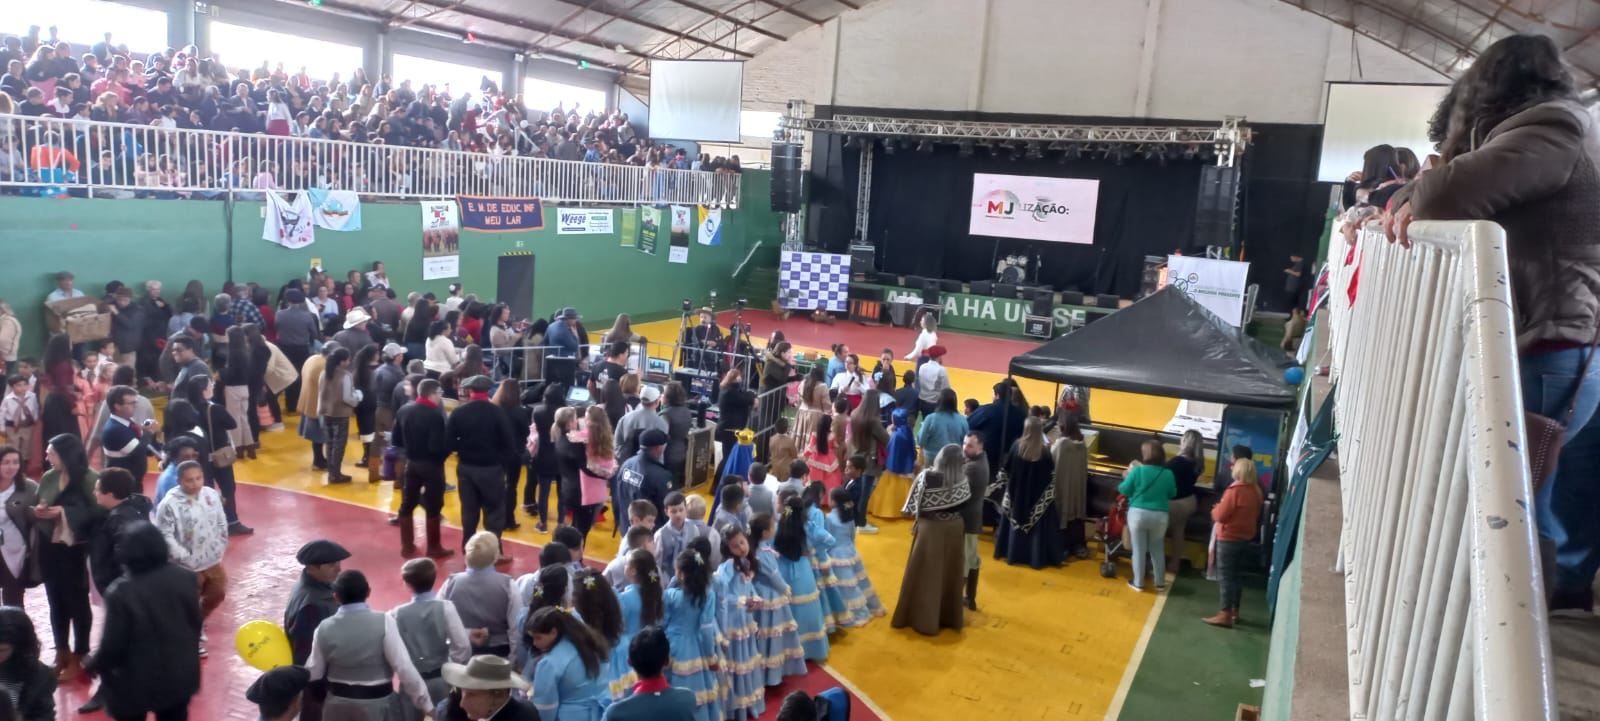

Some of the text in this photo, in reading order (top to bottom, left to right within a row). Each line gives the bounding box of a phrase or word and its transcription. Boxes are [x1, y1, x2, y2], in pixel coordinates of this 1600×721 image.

[486, 203, 498, 213] DE
[484, 215, 522, 225] MEU LAR
[963, 298, 997, 320] HÁ
